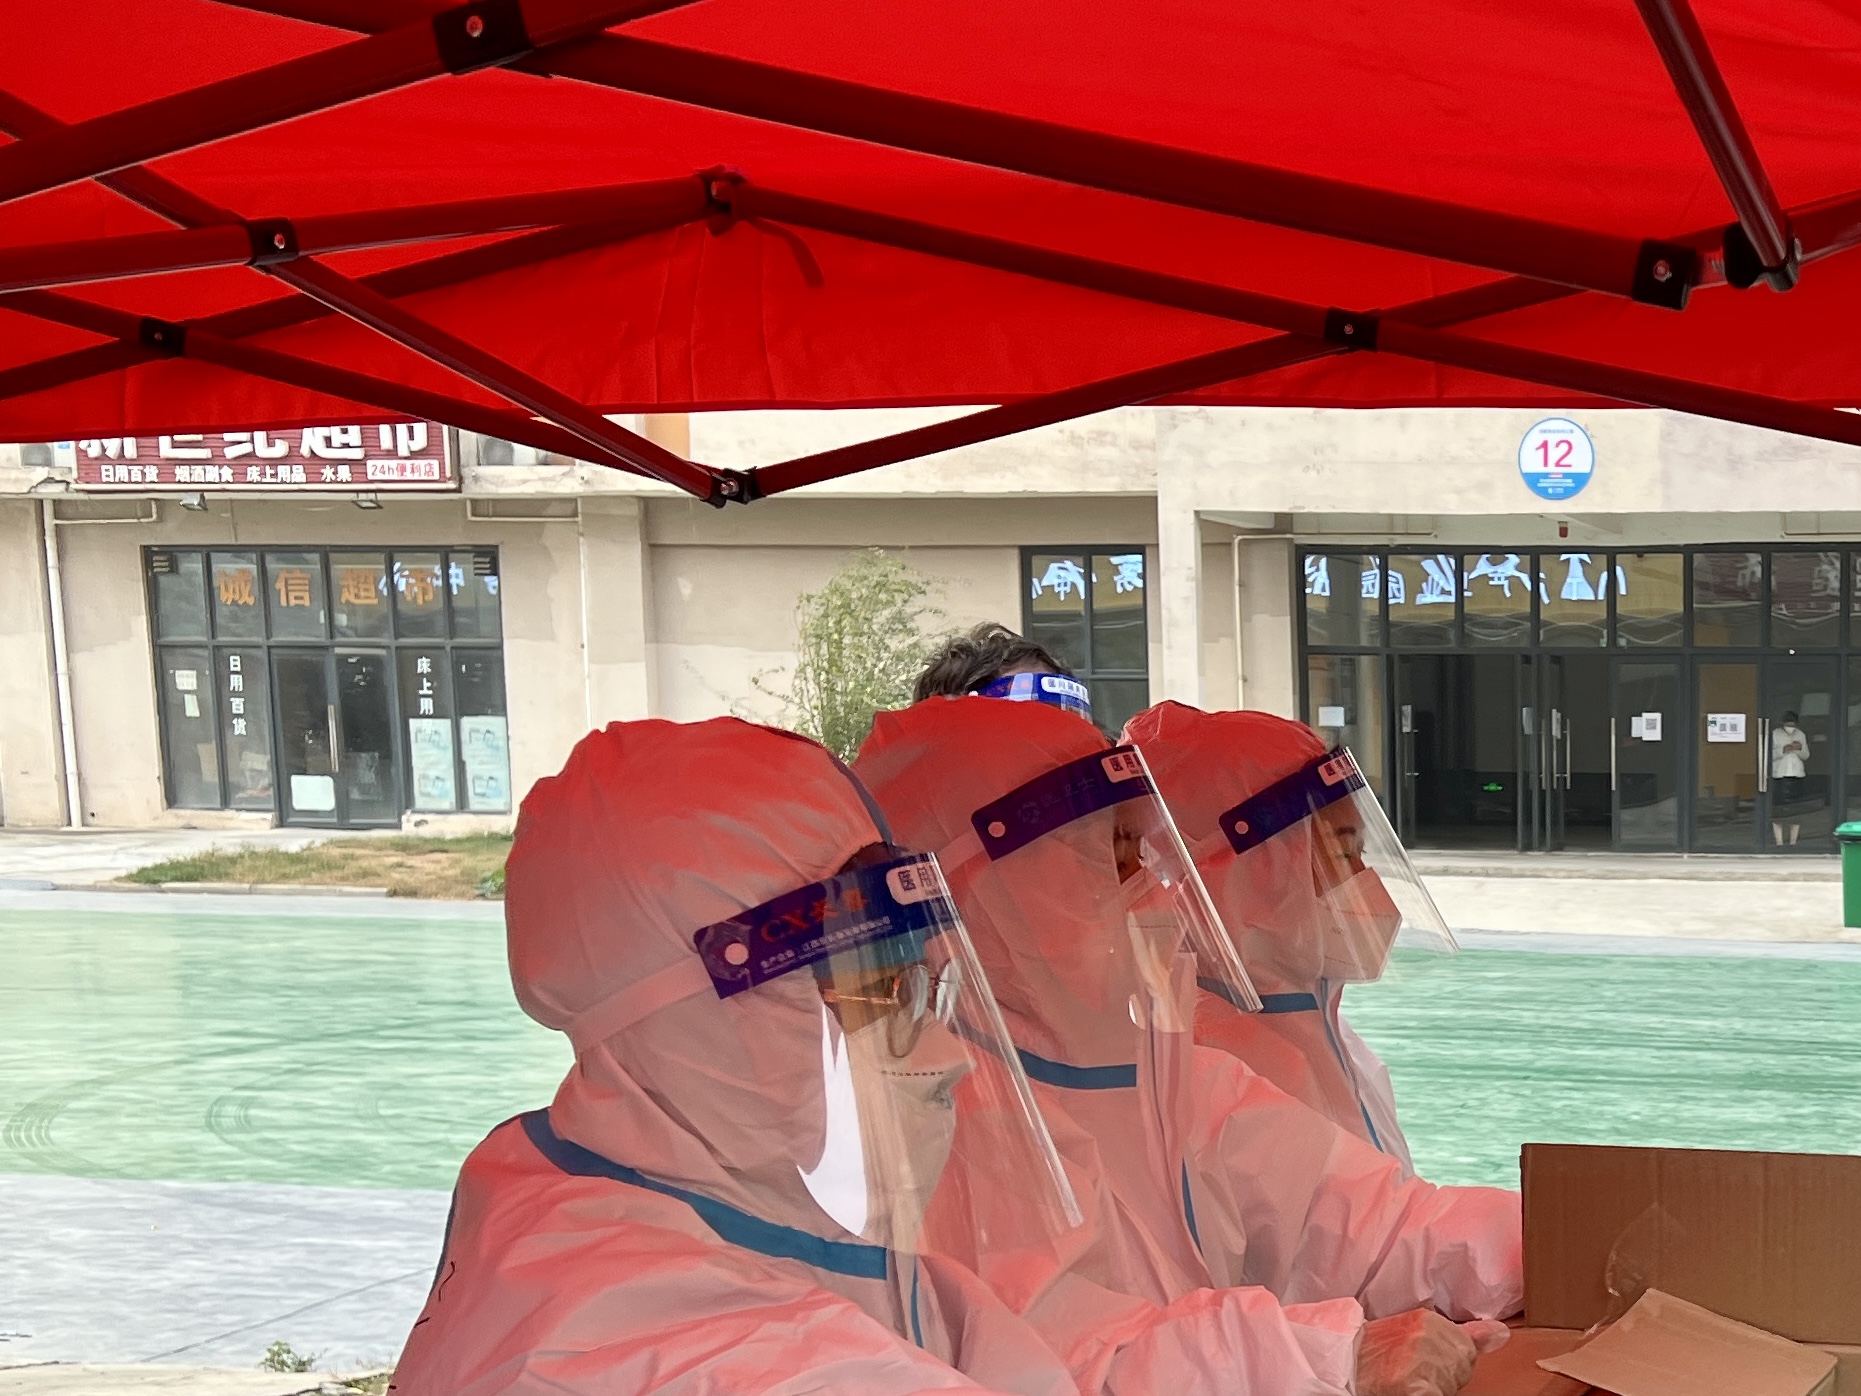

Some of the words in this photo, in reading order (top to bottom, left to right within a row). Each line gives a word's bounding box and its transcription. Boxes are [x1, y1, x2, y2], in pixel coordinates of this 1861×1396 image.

[1535, 439, 1573, 468] 12
[101, 465, 159, 483] 日用百货
[247, 465, 307, 483] 床上用品
[321, 465, 352, 483] 水果
[371, 464, 435, 478] 24h便利店
[219, 567, 435, 606] 诚信超市
[229, 655, 247, 736] 日用百货
[416, 656, 434, 717] 床上用
